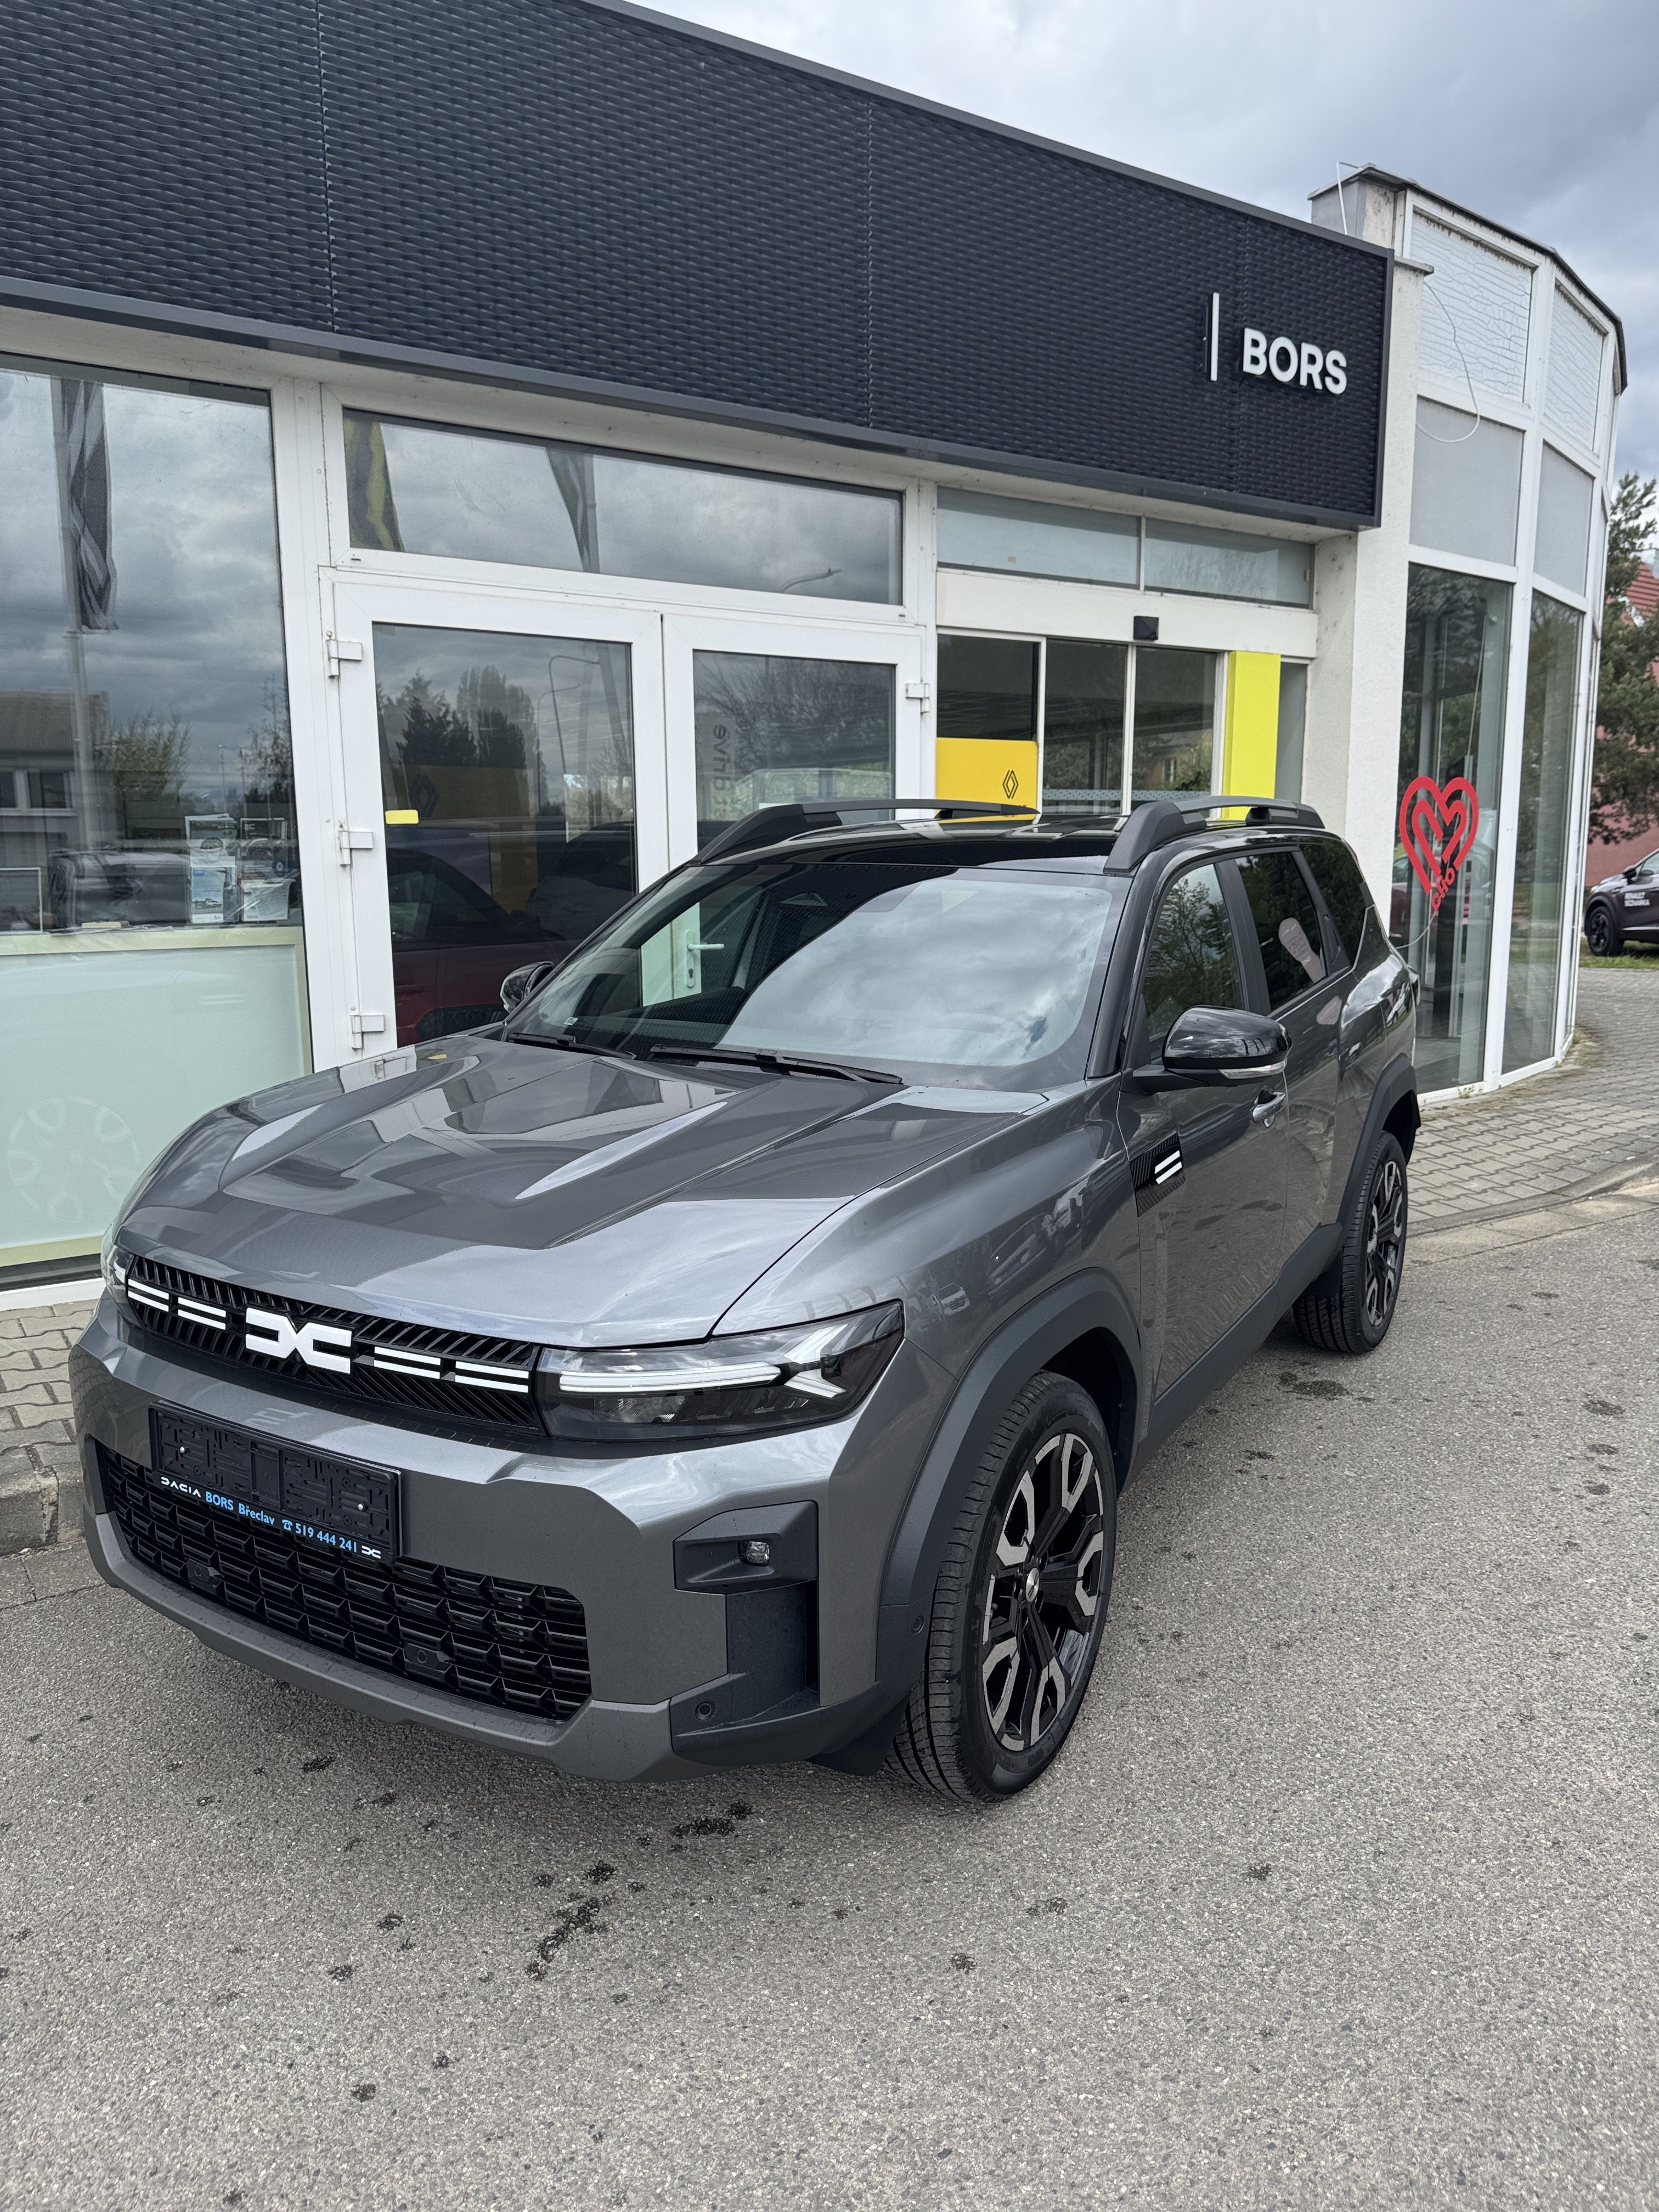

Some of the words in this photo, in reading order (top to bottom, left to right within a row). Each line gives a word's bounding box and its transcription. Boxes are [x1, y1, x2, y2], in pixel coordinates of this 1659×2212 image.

[1242, 327, 1347, 395] BORS
[161, 1476, 201, 1498] DACIA
[205, 1491, 234, 1511] BORS
[238, 1503, 275, 1525] Břeclav
[295, 1522, 314, 1538] 519
[317, 1530, 336, 1546] 444
[339, 1537, 357, 1553] 241
